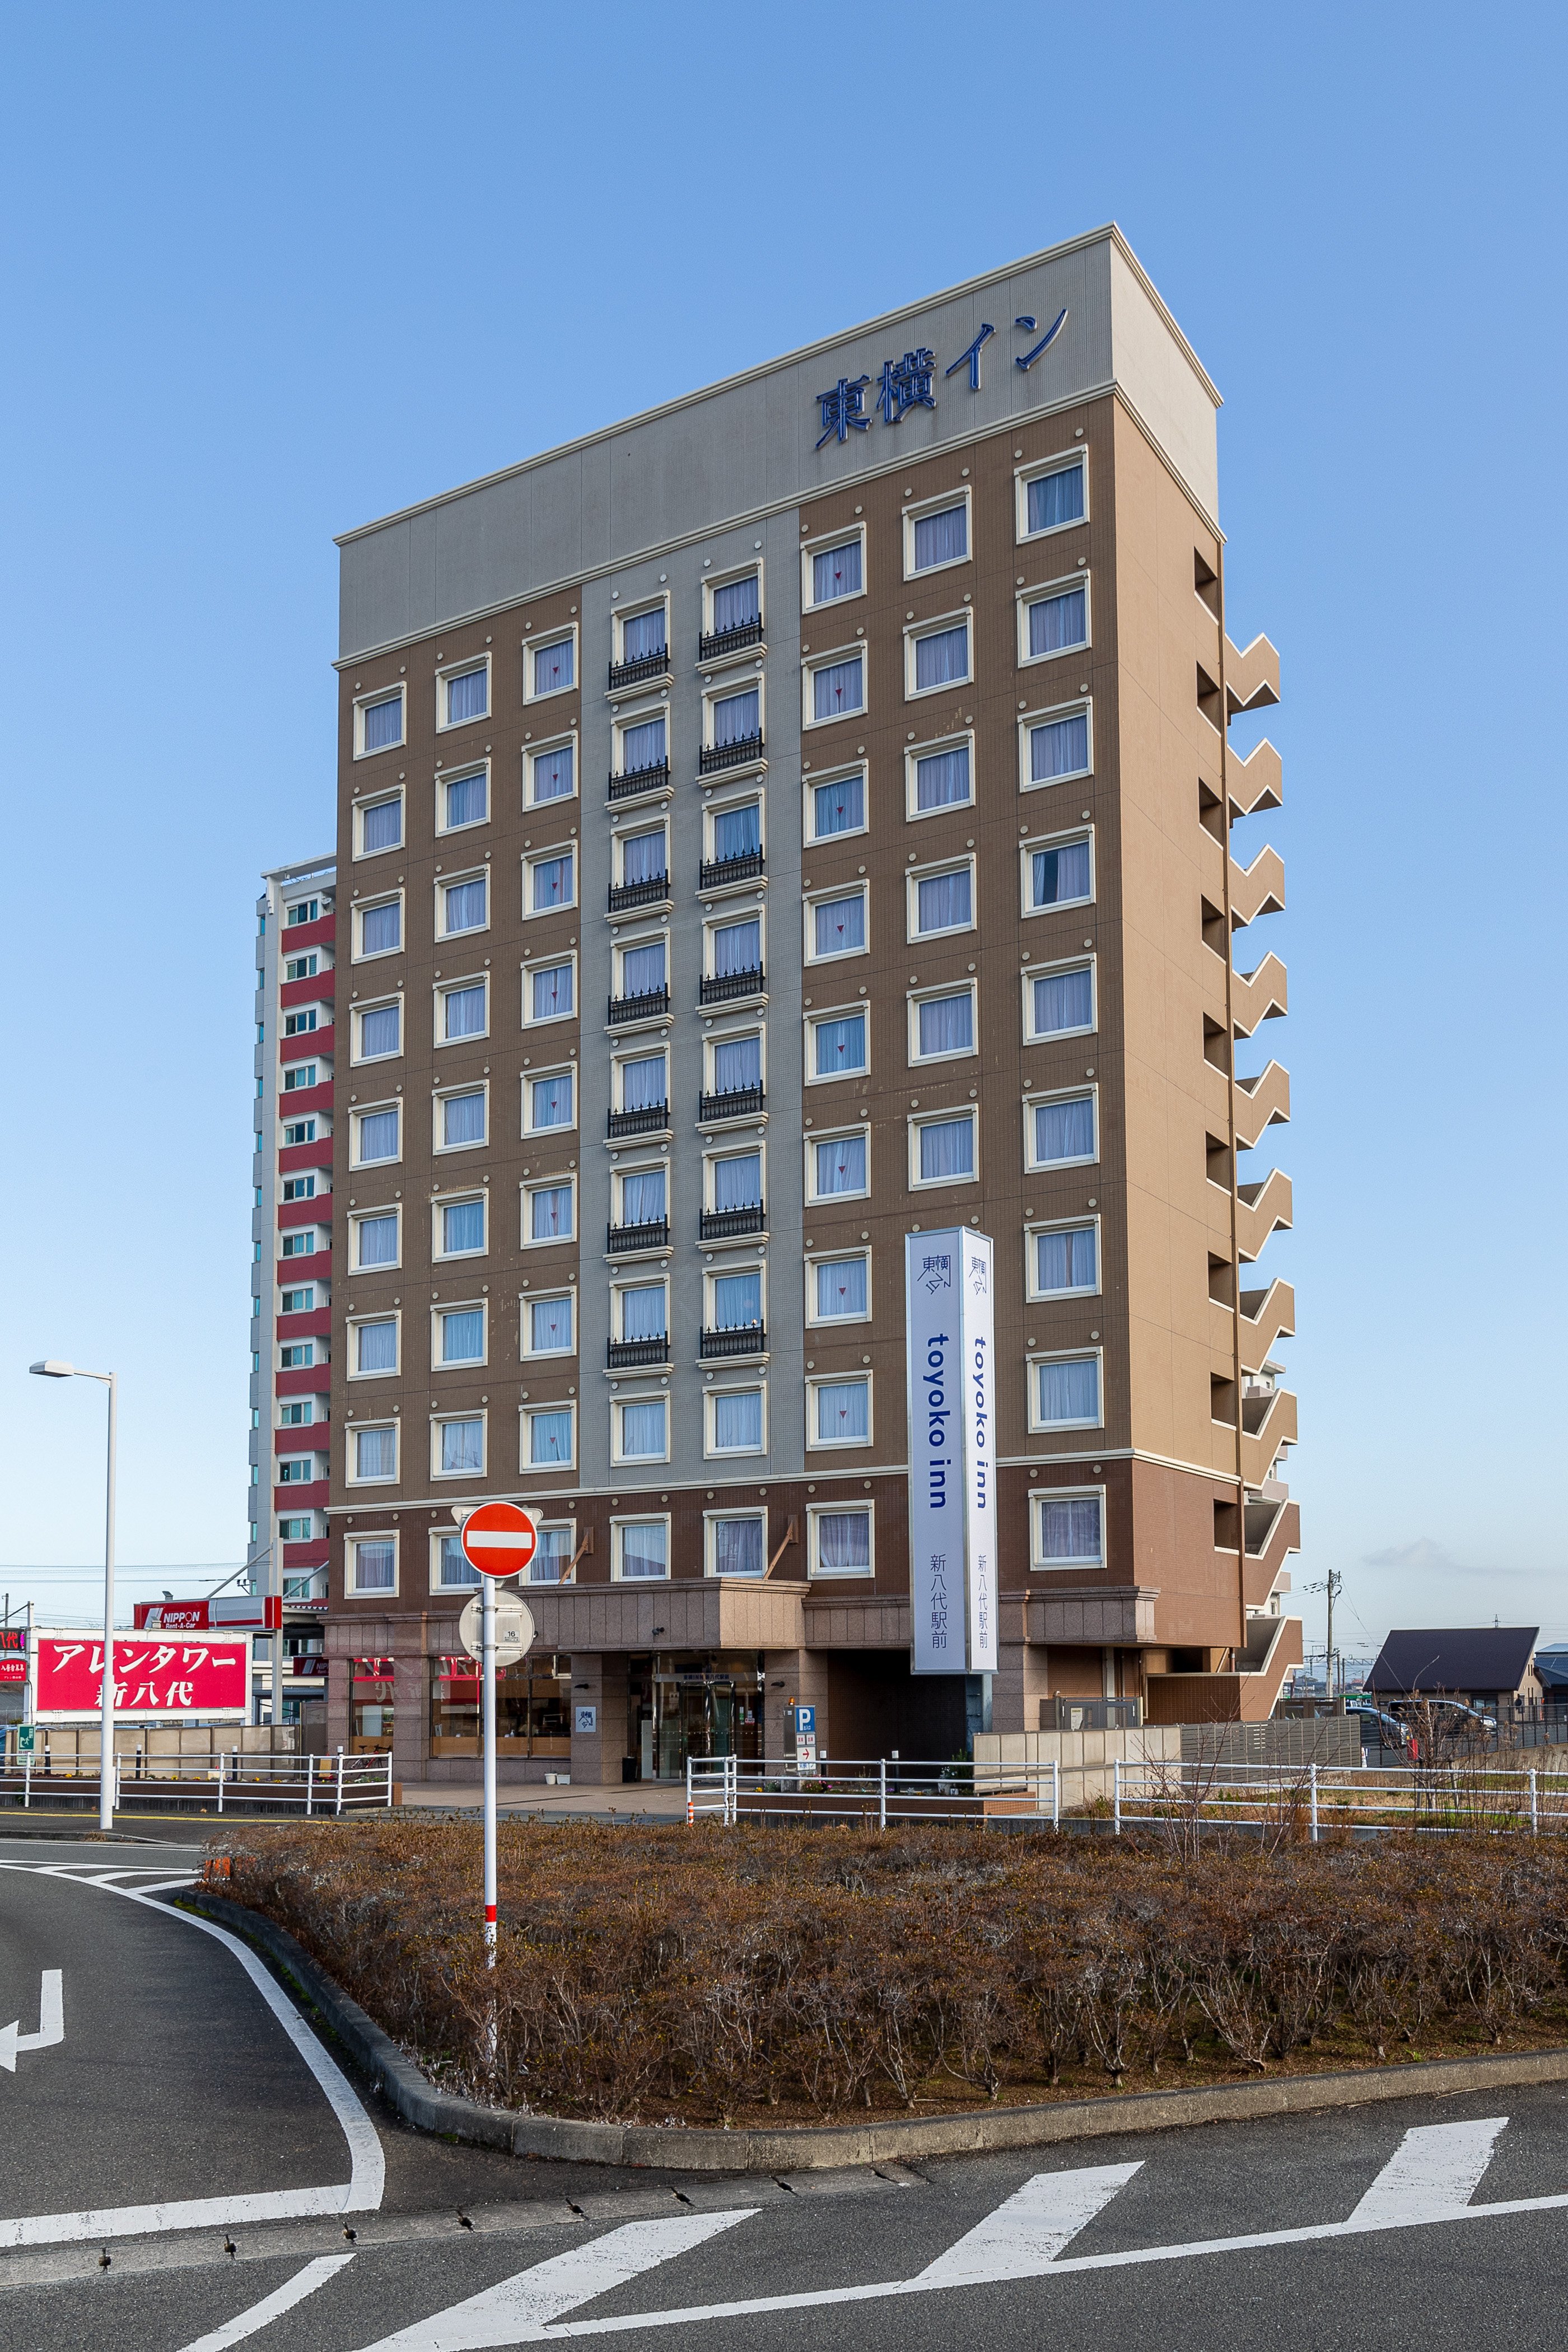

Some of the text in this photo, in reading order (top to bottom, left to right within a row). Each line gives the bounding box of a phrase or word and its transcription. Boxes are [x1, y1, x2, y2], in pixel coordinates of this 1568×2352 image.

[815, 309, 1068, 449] 東横イン
[923, 1333, 951, 1509] toyoko inn
[973, 1336, 988, 1509] toyoko inn
[164, 1612, 200, 1623] NIPPON
[930, 1554, 948, 1649] 新八代駅前
[978, 1554, 988, 1649] 新八代駅前
[52, 1644, 236, 1674] アレンタワー
[94, 1681, 194, 1707] 新八代
[799, 1709, 811, 1731] P
